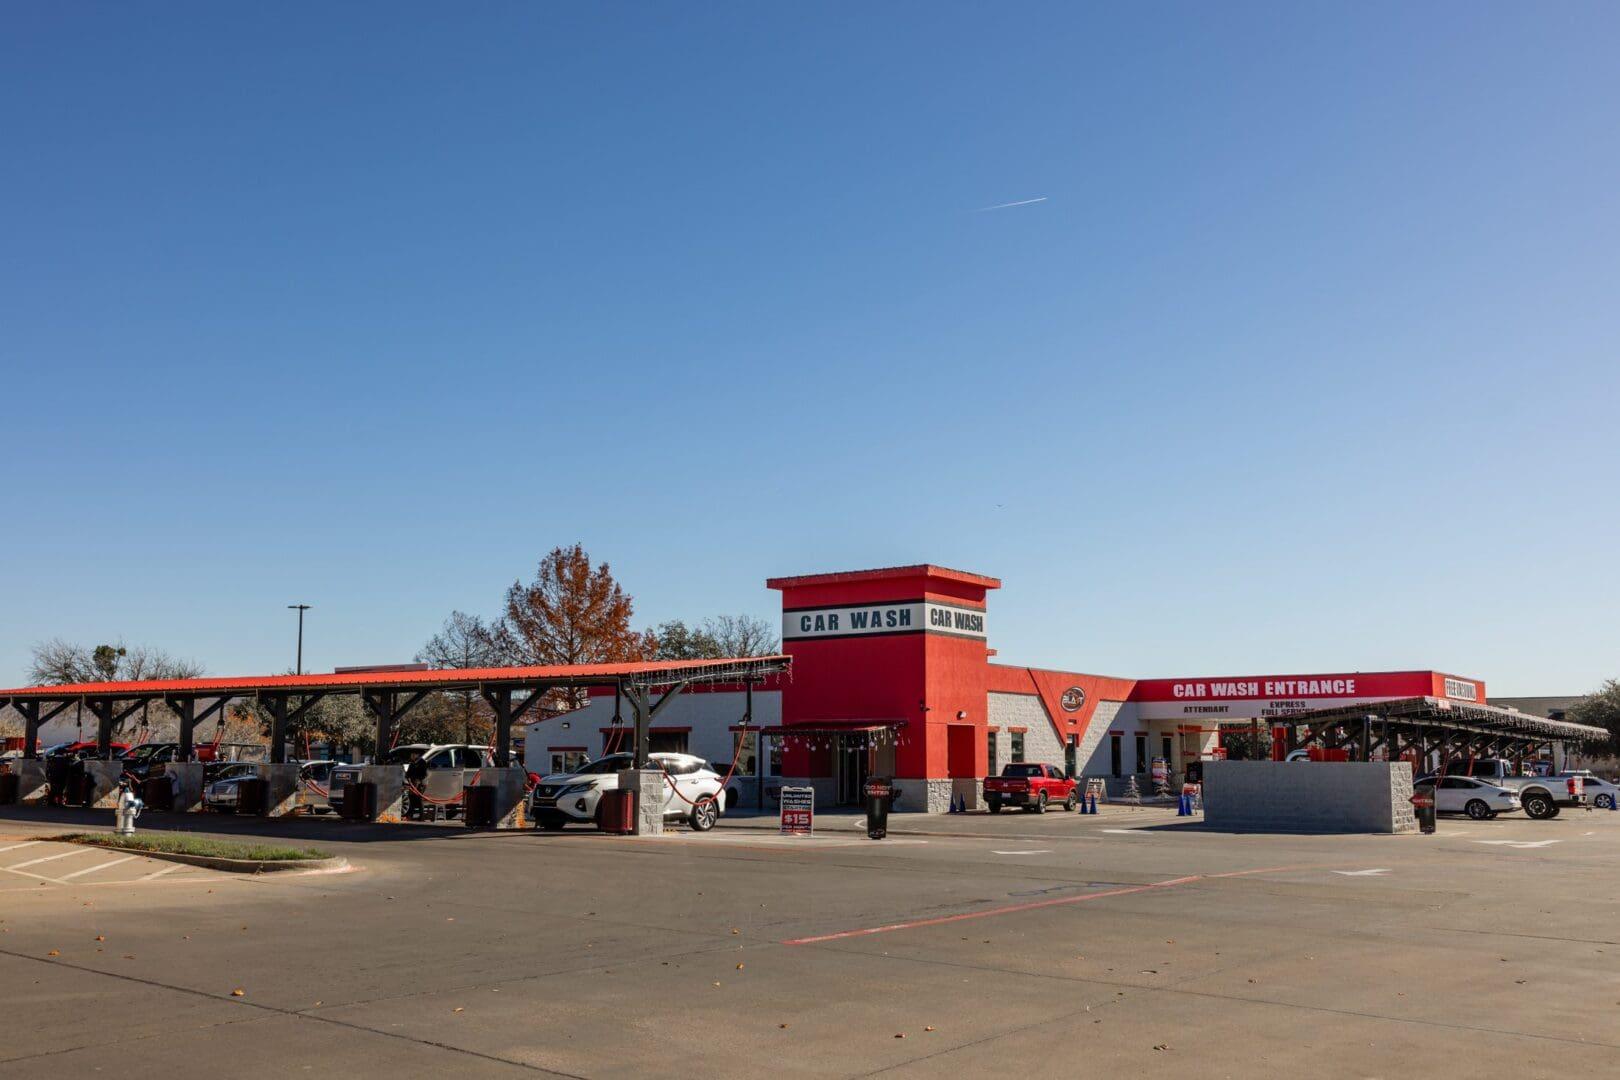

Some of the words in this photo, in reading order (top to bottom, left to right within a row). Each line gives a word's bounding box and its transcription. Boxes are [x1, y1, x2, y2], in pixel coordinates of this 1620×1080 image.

[800, 614, 839, 632] CAR
[850, 608, 911, 629] WASH
[931, 608, 951, 628] CAR
[954, 612, 983, 632] WASH
[1173, 683, 1206, 697] CAR
[1210, 682, 1258, 697] WASH
[1265, 679, 1355, 696] ENTRANCE
[1183, 706, 1229, 714] ATTENDANT
[784, 814, 808, 824] $15
